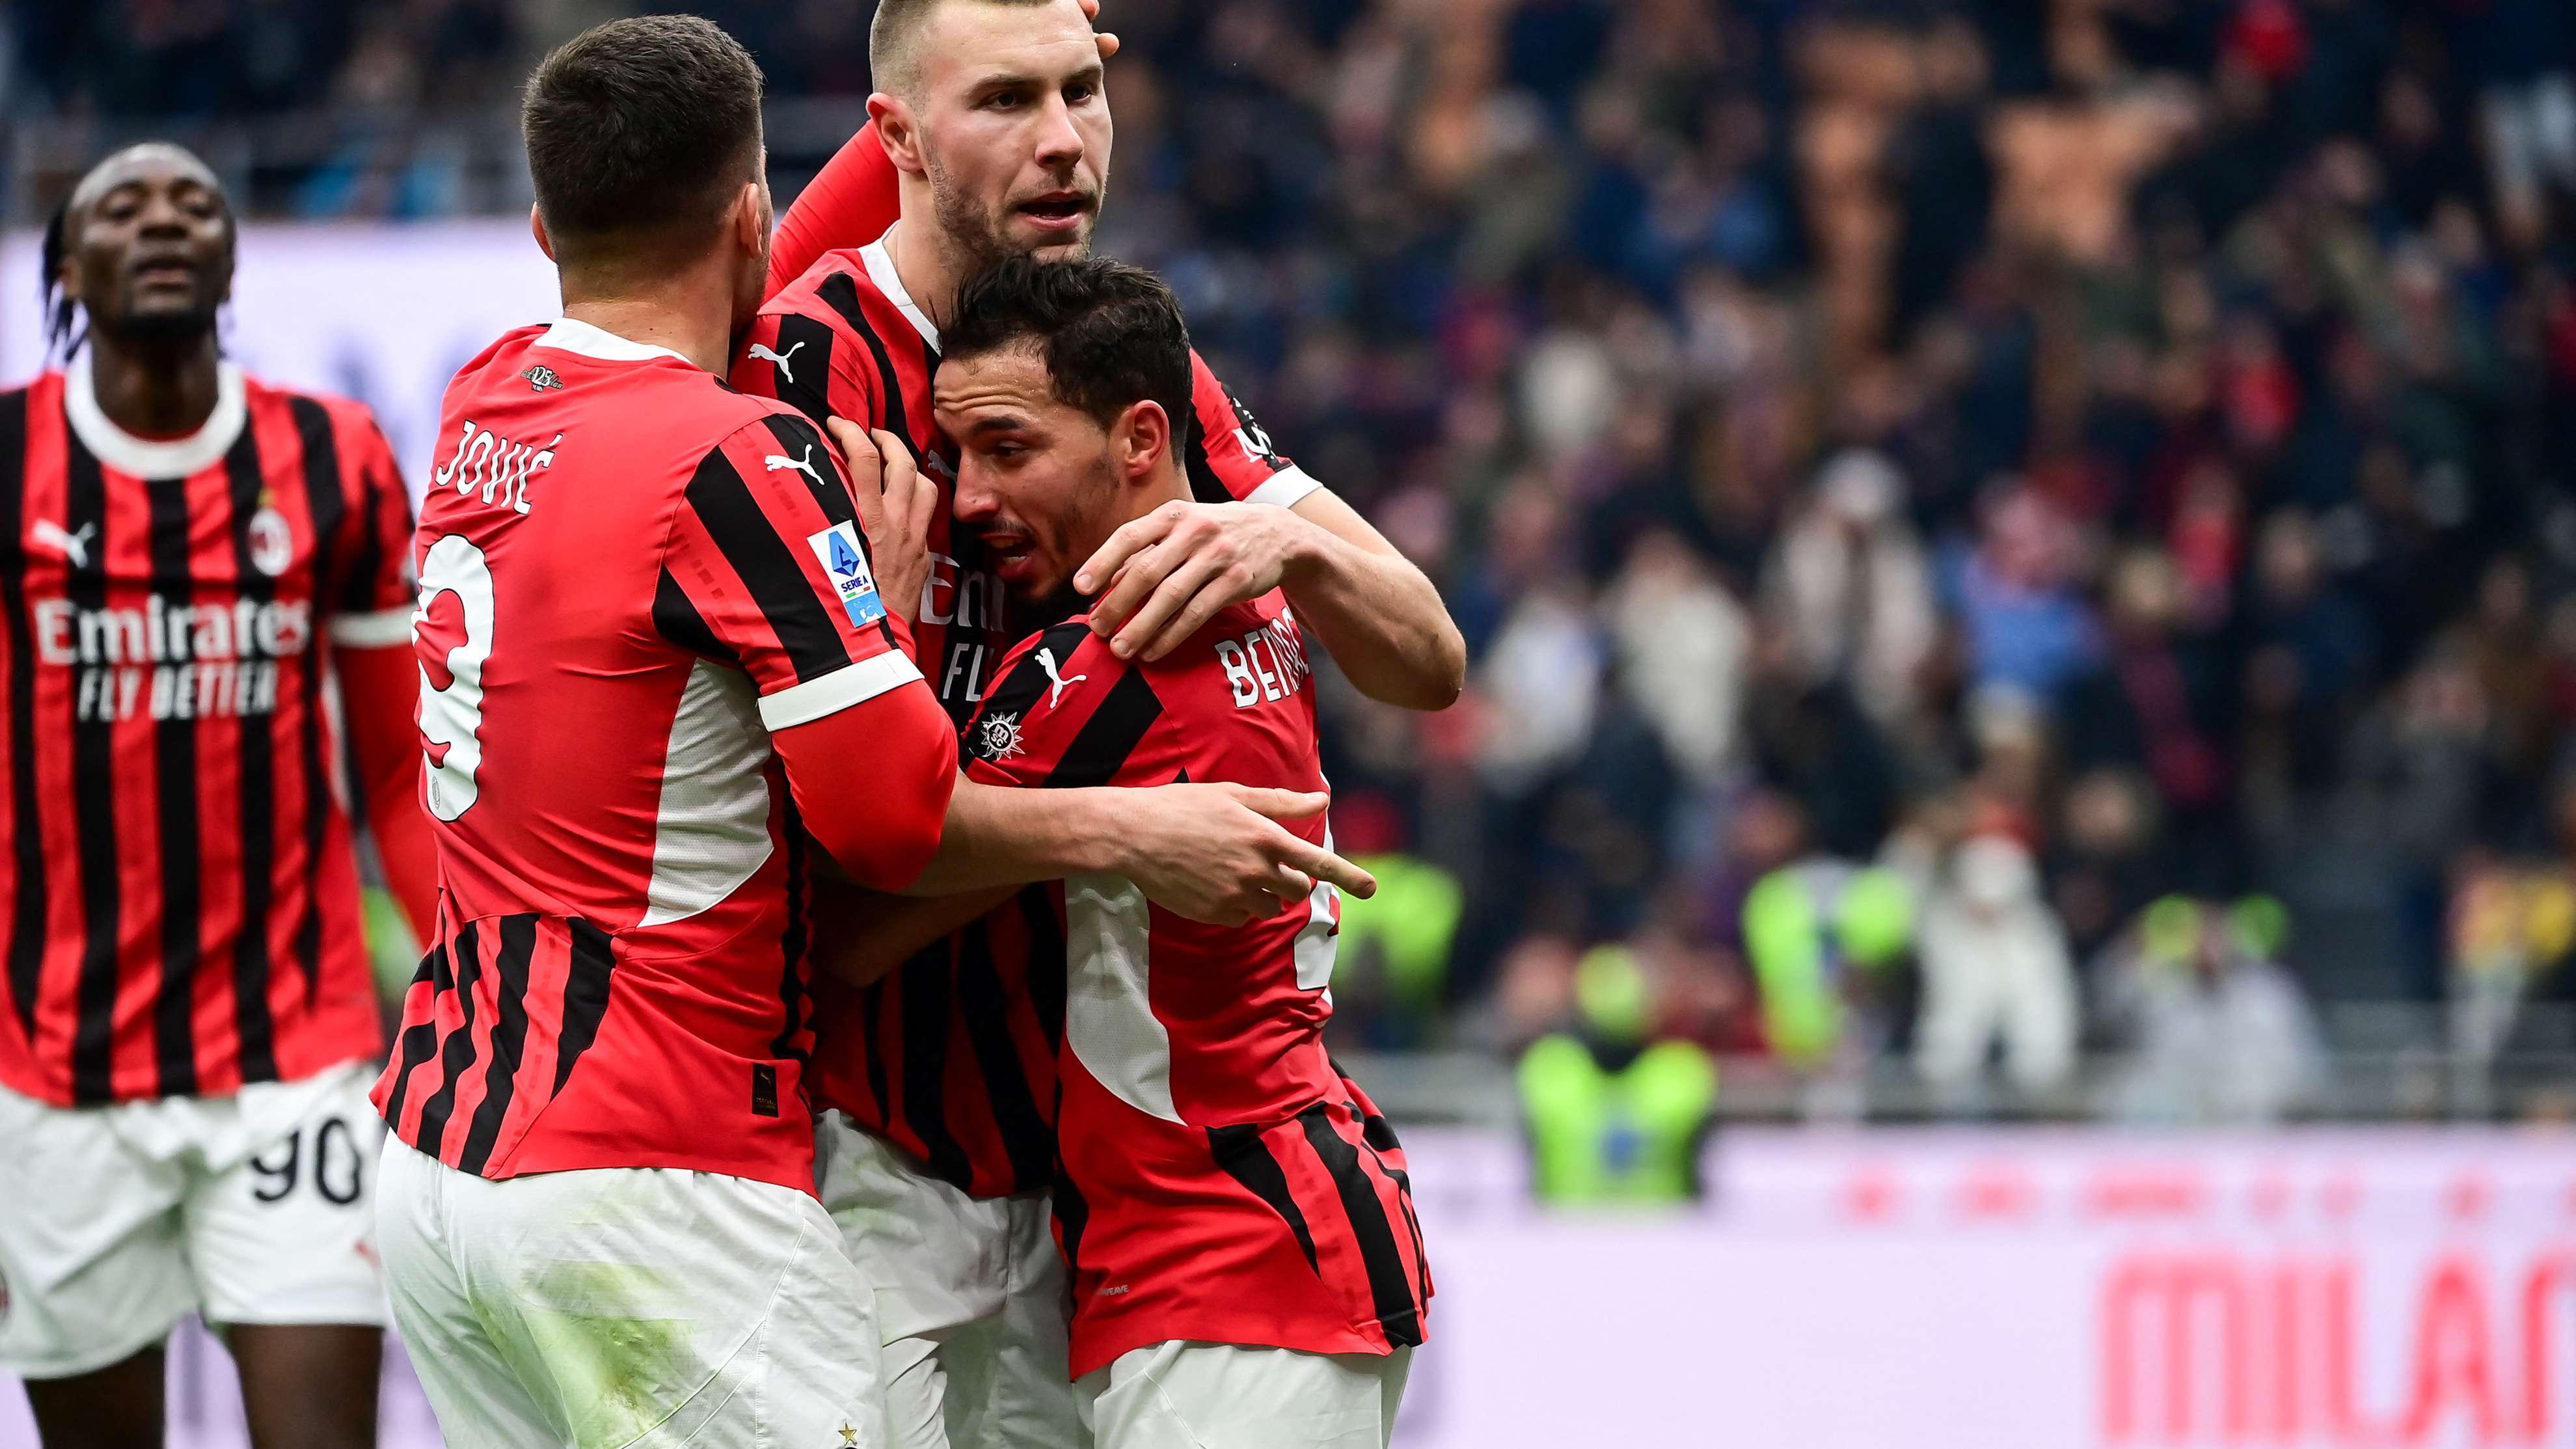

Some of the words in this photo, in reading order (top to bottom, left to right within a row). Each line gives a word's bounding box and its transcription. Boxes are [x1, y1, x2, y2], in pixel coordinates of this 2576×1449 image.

[435, 419, 563, 515] JOVIĆ
[841, 576, 863, 593] SERIE
[863, 575, 869, 585] A
[34, 593, 310, 665] Emirates
[77, 664, 138, 722] FLY
[150, 662, 277, 721] BETTER
[411, 534, 495, 822] 9
[942, 643, 994, 701] FL
[251, 1117, 362, 1204] 90
